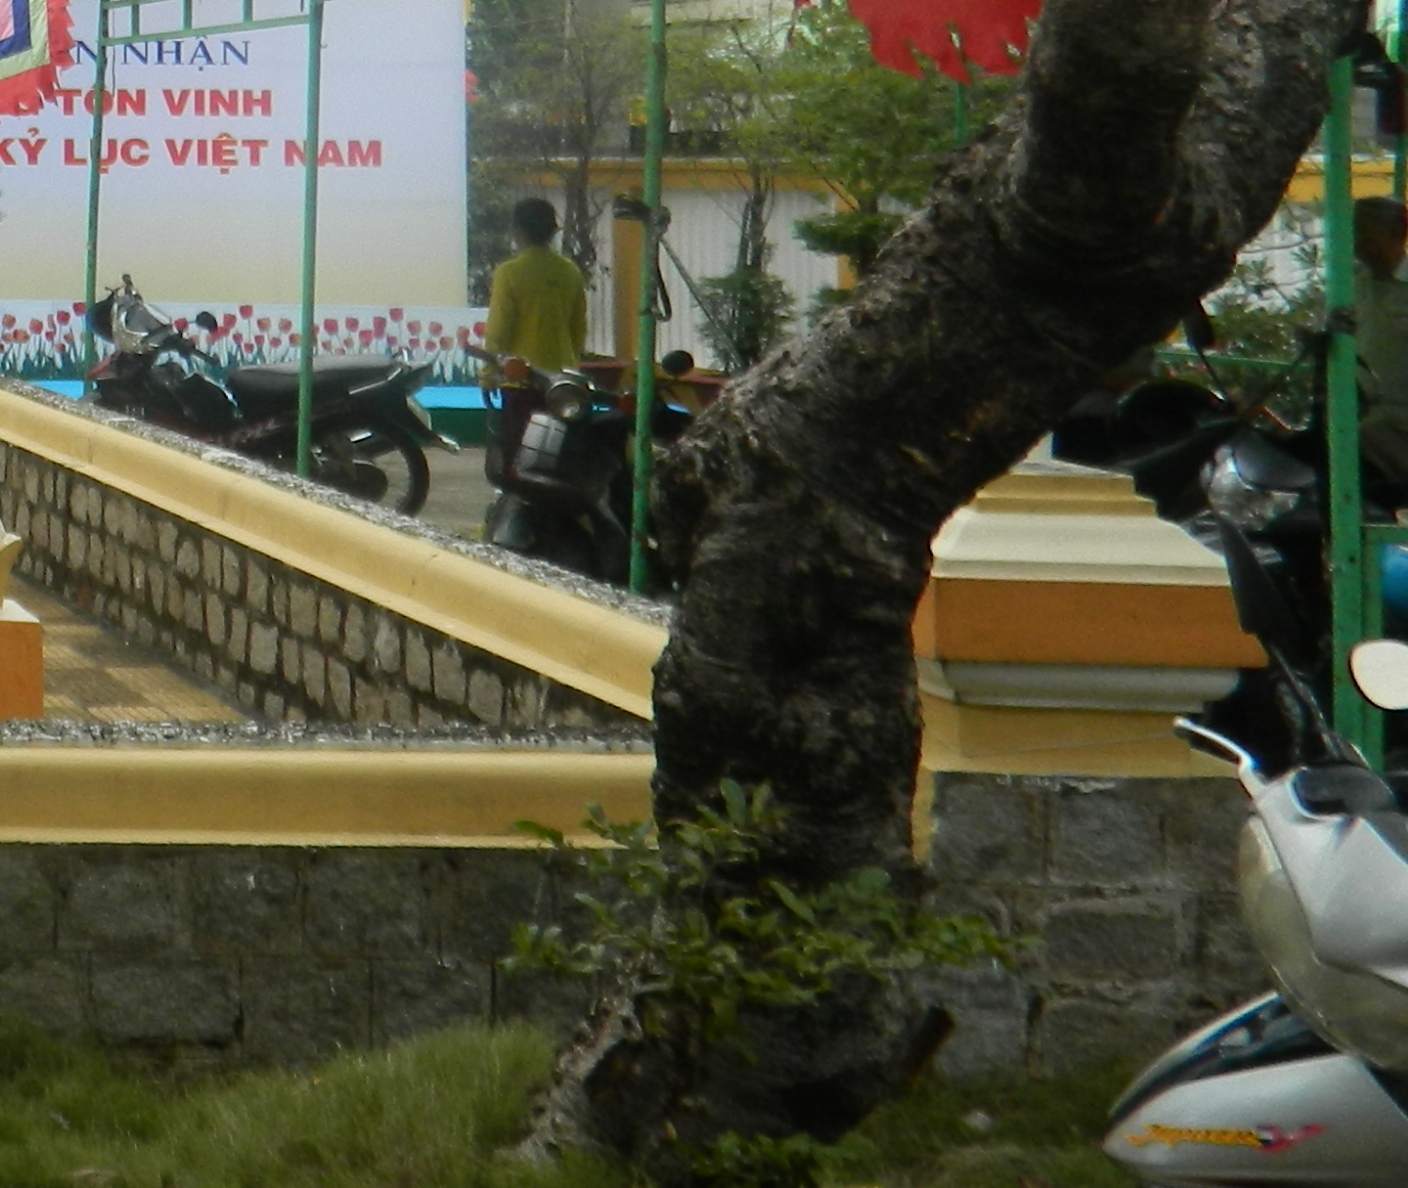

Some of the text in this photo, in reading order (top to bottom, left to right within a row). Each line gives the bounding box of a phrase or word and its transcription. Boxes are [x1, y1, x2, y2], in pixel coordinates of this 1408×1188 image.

[121, 35, 252, 72] NHẬN
[162, 88, 273, 117] VINH
[64, 137, 150, 175] LỤC
[165, 132, 268, 175] VIỆT
[284, 139, 382, 168] NAM
